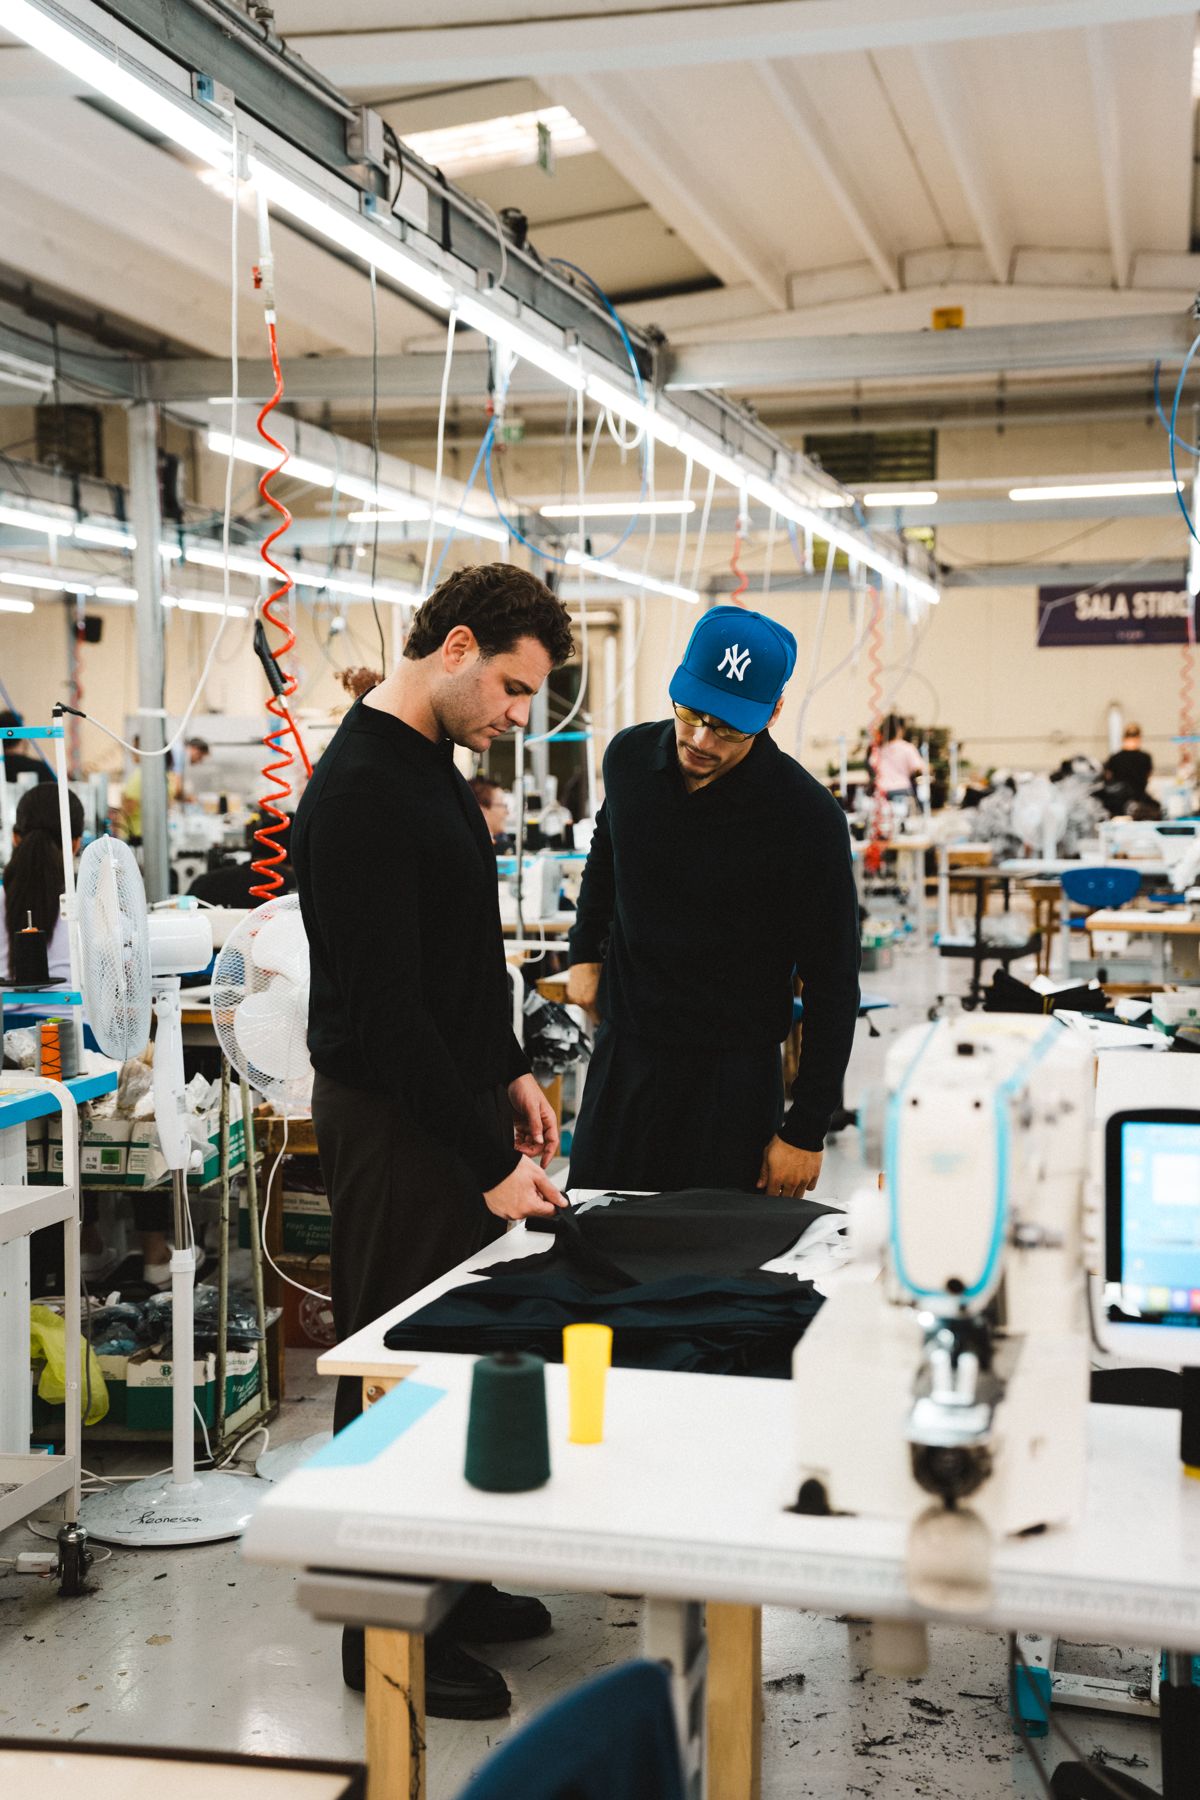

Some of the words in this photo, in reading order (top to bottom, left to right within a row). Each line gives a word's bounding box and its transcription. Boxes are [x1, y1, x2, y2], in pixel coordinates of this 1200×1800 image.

[1075, 592, 1130, 621] SALA
[717, 643, 752, 682] NY
[129, 1511, 202, 1524] Leonessa
